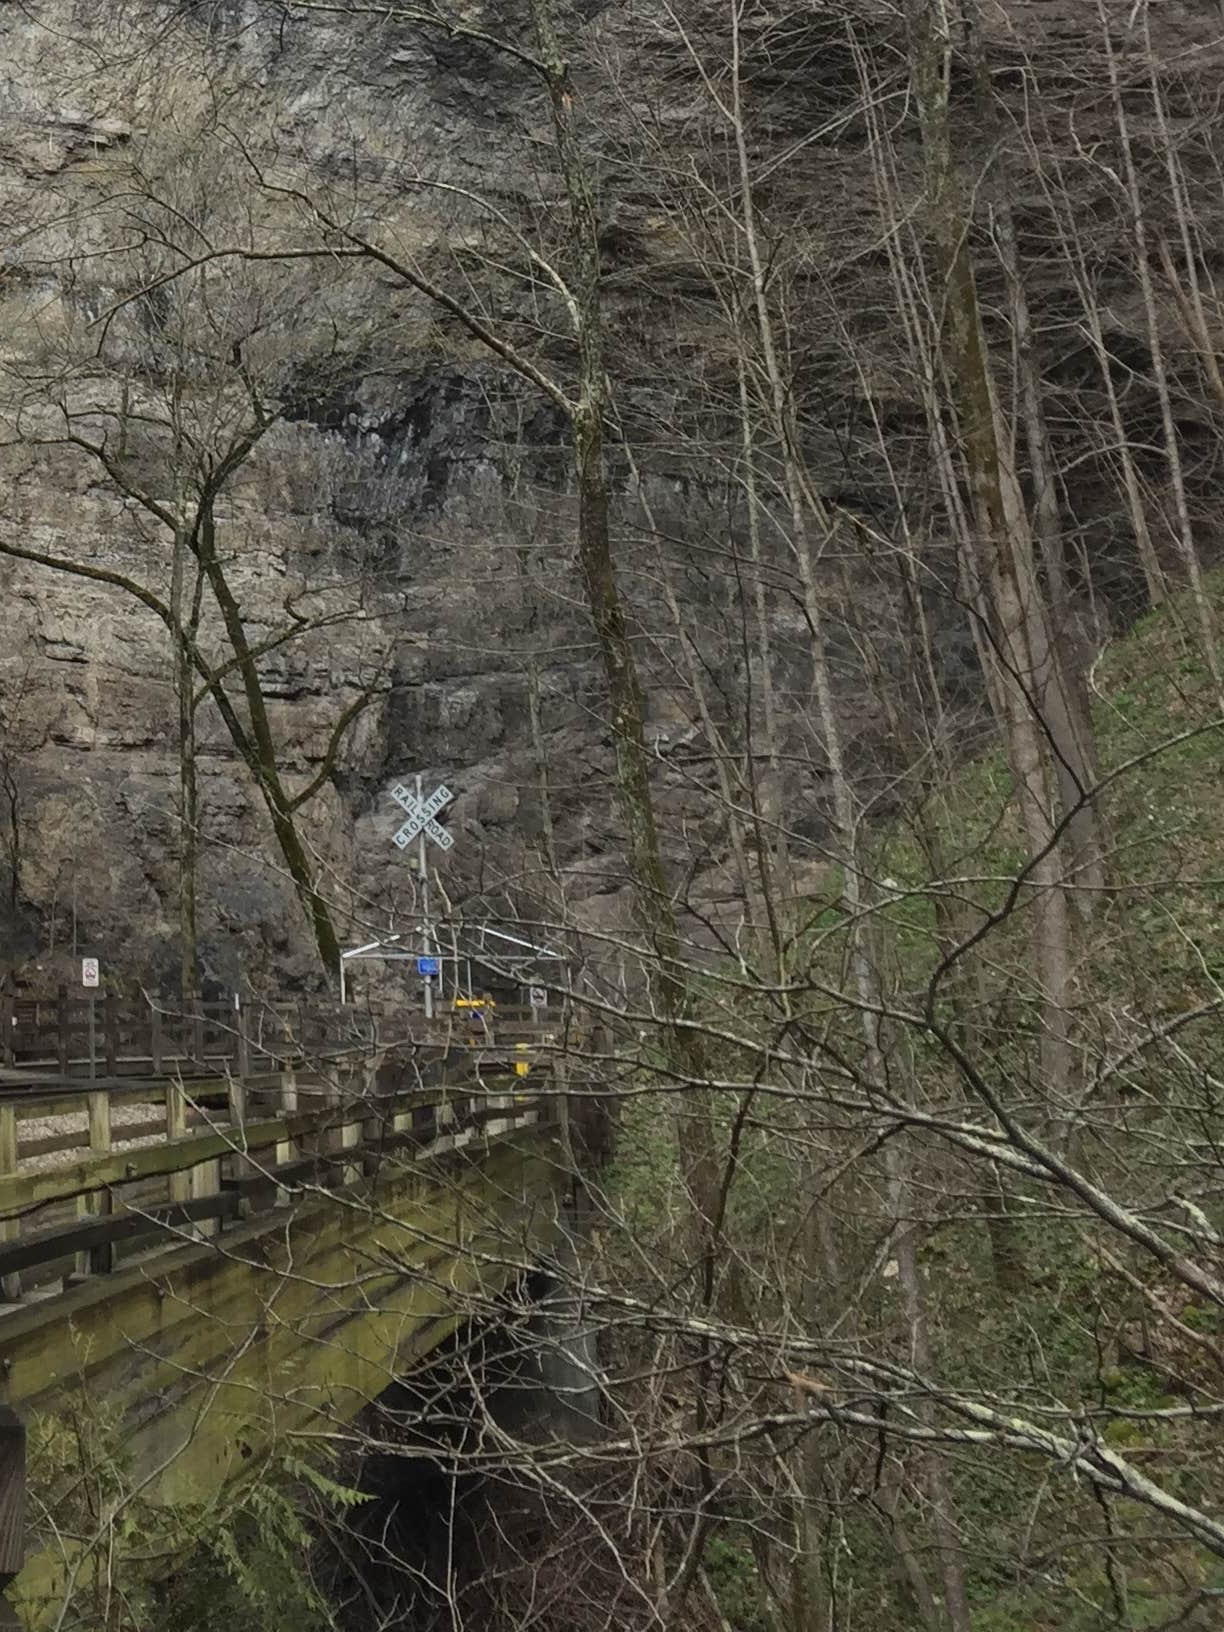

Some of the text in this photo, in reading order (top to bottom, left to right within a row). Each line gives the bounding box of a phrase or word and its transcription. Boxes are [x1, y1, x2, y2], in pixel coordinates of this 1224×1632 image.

[394, 787, 451, 846] RAIL ROAD
[396, 788, 450, 845] CROSSING
